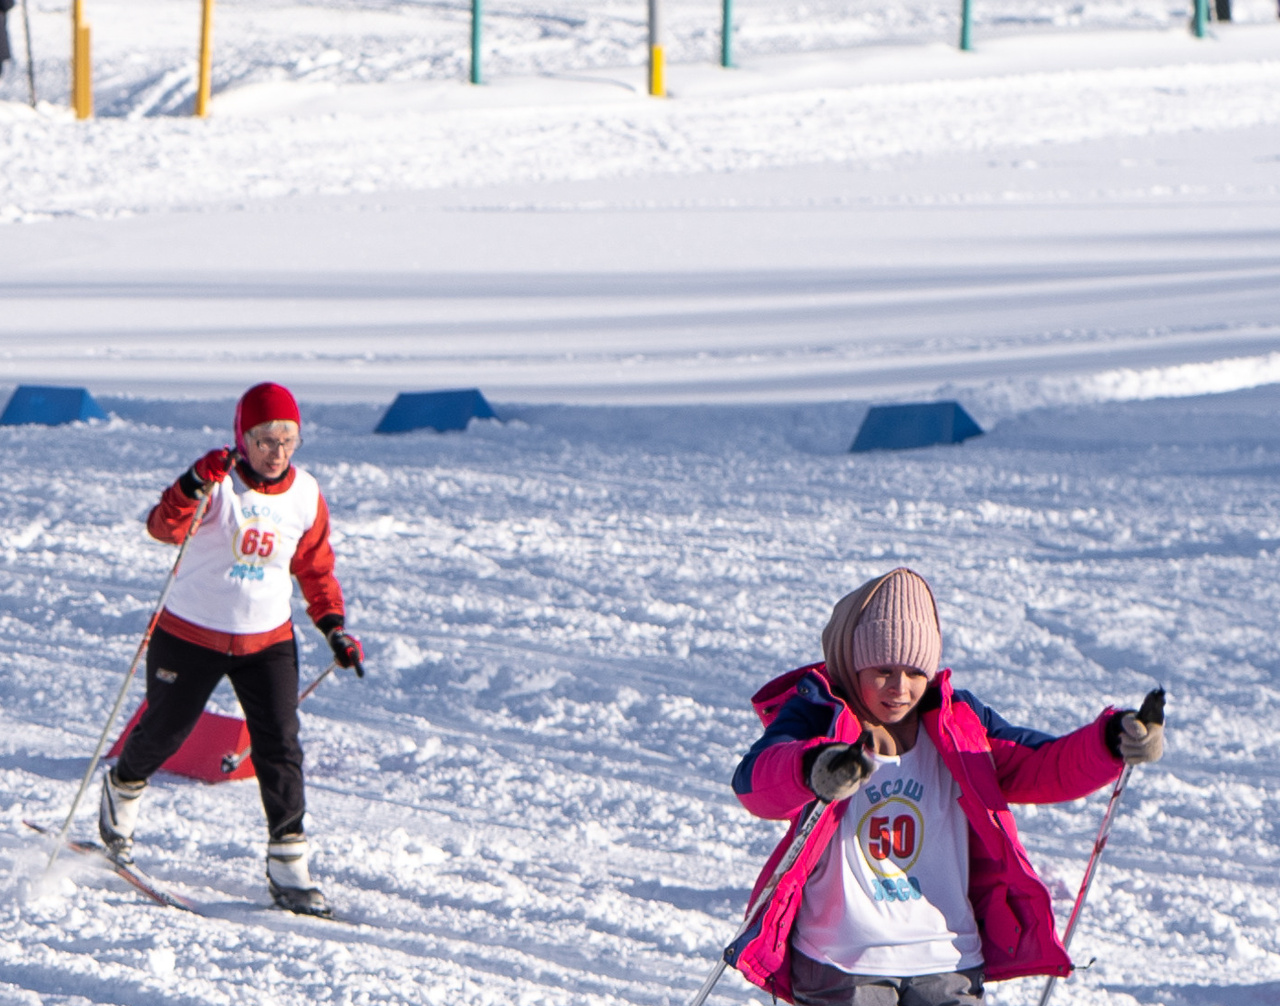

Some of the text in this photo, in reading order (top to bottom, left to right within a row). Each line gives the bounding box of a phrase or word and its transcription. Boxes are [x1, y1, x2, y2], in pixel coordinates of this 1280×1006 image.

[241, 528, 274, 557] 65
[865, 778, 923, 804] БСОШ
[869, 814, 915, 860] 50
